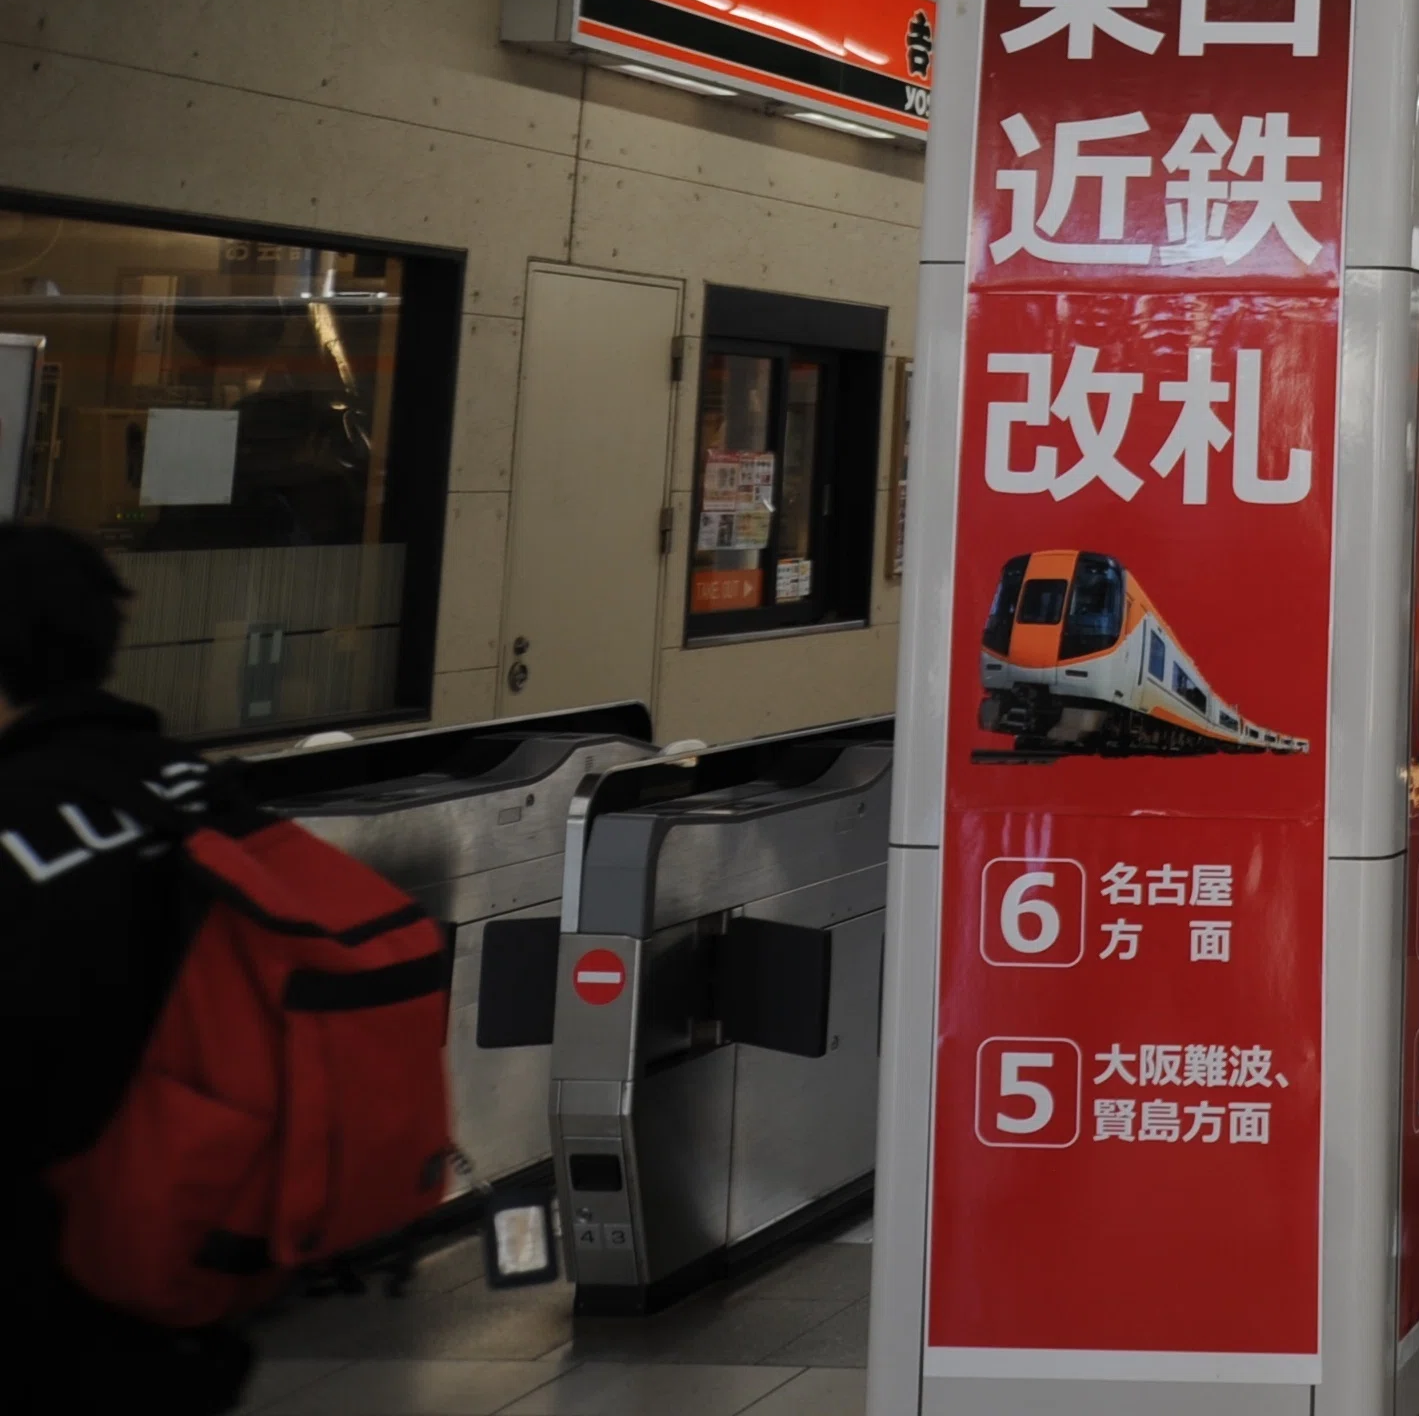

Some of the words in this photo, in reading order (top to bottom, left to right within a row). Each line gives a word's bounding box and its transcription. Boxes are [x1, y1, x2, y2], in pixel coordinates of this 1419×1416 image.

[989, 111, 1324, 267] 近鉄
[984, 347, 1312, 505] 改札
[999, 872, 1060, 954] 6
[1100, 863, 1234, 908] 名古屋
[995, 1052, 1054, 1134] 5
[1093, 1044, 1290, 1089] 大阪難波、
[1093, 1098, 1271, 1144] 賢島方面
[580, 1230, 594, 1243] 4
[612, 1230, 625, 1244] 3
